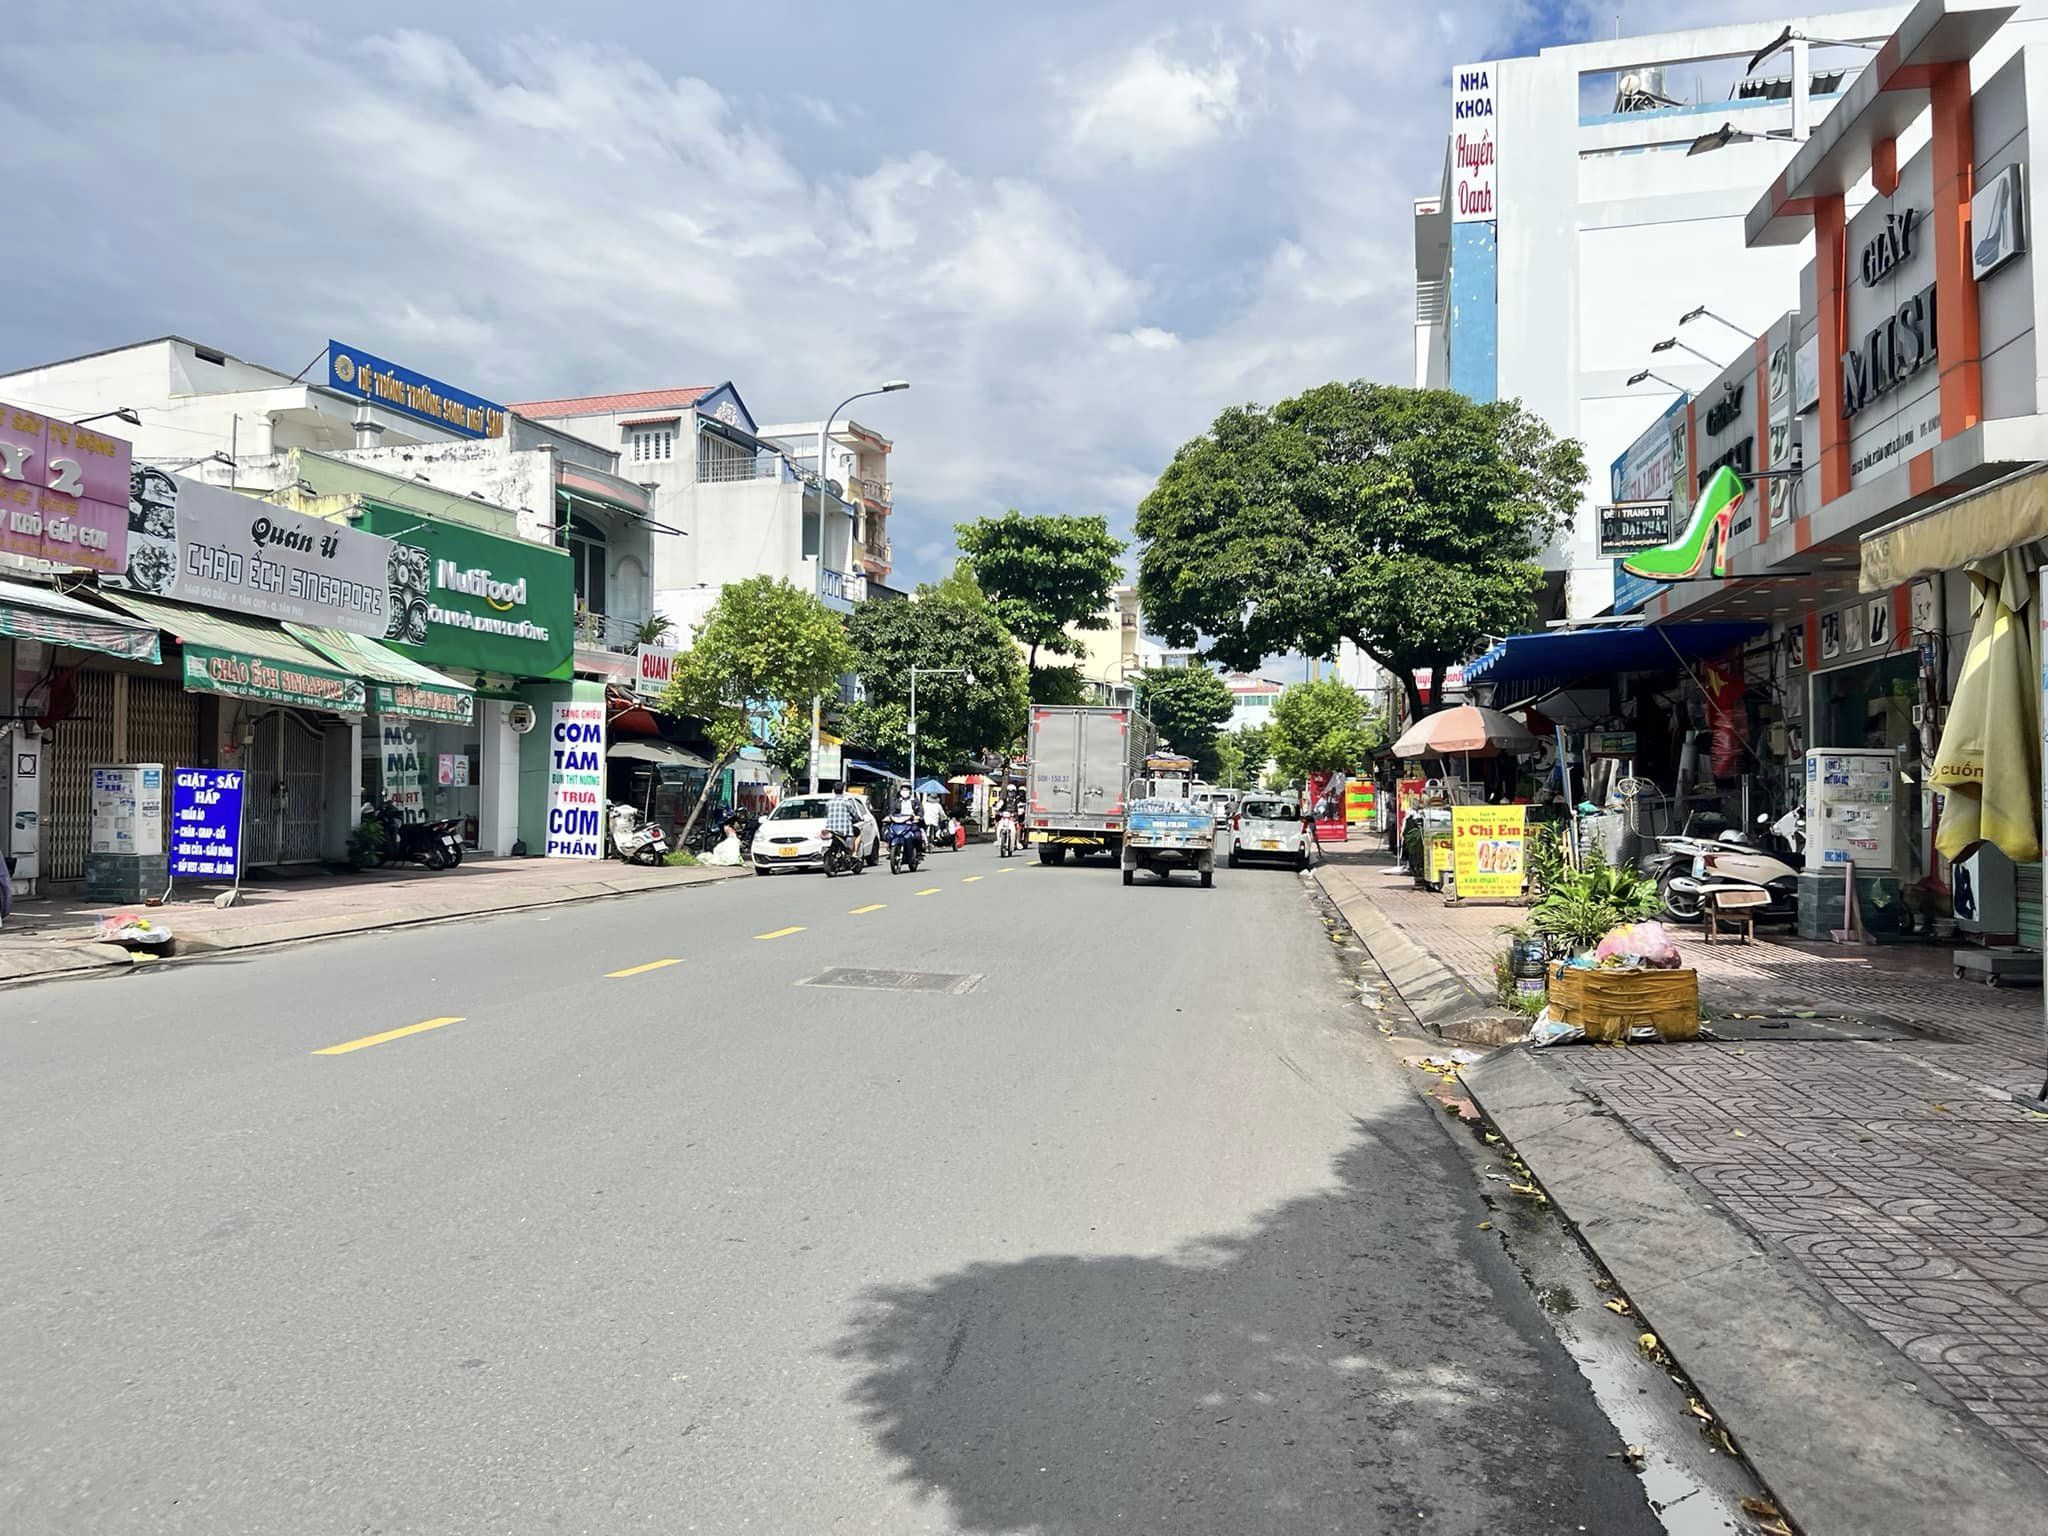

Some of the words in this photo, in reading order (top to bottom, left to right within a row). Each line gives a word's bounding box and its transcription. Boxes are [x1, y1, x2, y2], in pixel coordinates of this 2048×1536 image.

[1460, 72, 1489, 92] NHA
[1455, 98, 1493, 119] KHOA
[1456, 128, 1494, 177] Huyền
[1458, 180, 1493, 215] Oanh
[1859, 208, 1915, 288] GIÀY
[443, 398, 465, 427] SONG
[48, 458, 84, 498] 2
[1622, 508, 1650, 518] TRANG
[1651, 506, 1665, 517] TRÍ
[251, 517, 313, 554] Quán
[1622, 521, 1639, 538] ĐẠI
[1642, 517, 1668, 535] PHÁT
[289, 568, 382, 616] SINGAPORE
[436, 558, 527, 605] Nutifood
[281, 671, 344, 701] SINGAPORE
[554, 722, 602, 743] CƠM
[554, 744, 600, 771] TẤM
[1941, 760, 1984, 777] cuốn
[177, 772, 208, 790] GIẶT
[216, 772, 241, 790] SẤY
[195, 788, 221, 804] HẤP
[562, 791, 597, 804] TRƯA
[550, 807, 599, 836] CƠM
[1456, 826, 1465, 838] 3
[1469, 825, 1493, 840] Chị
[1498, 824, 1521, 836] Em
